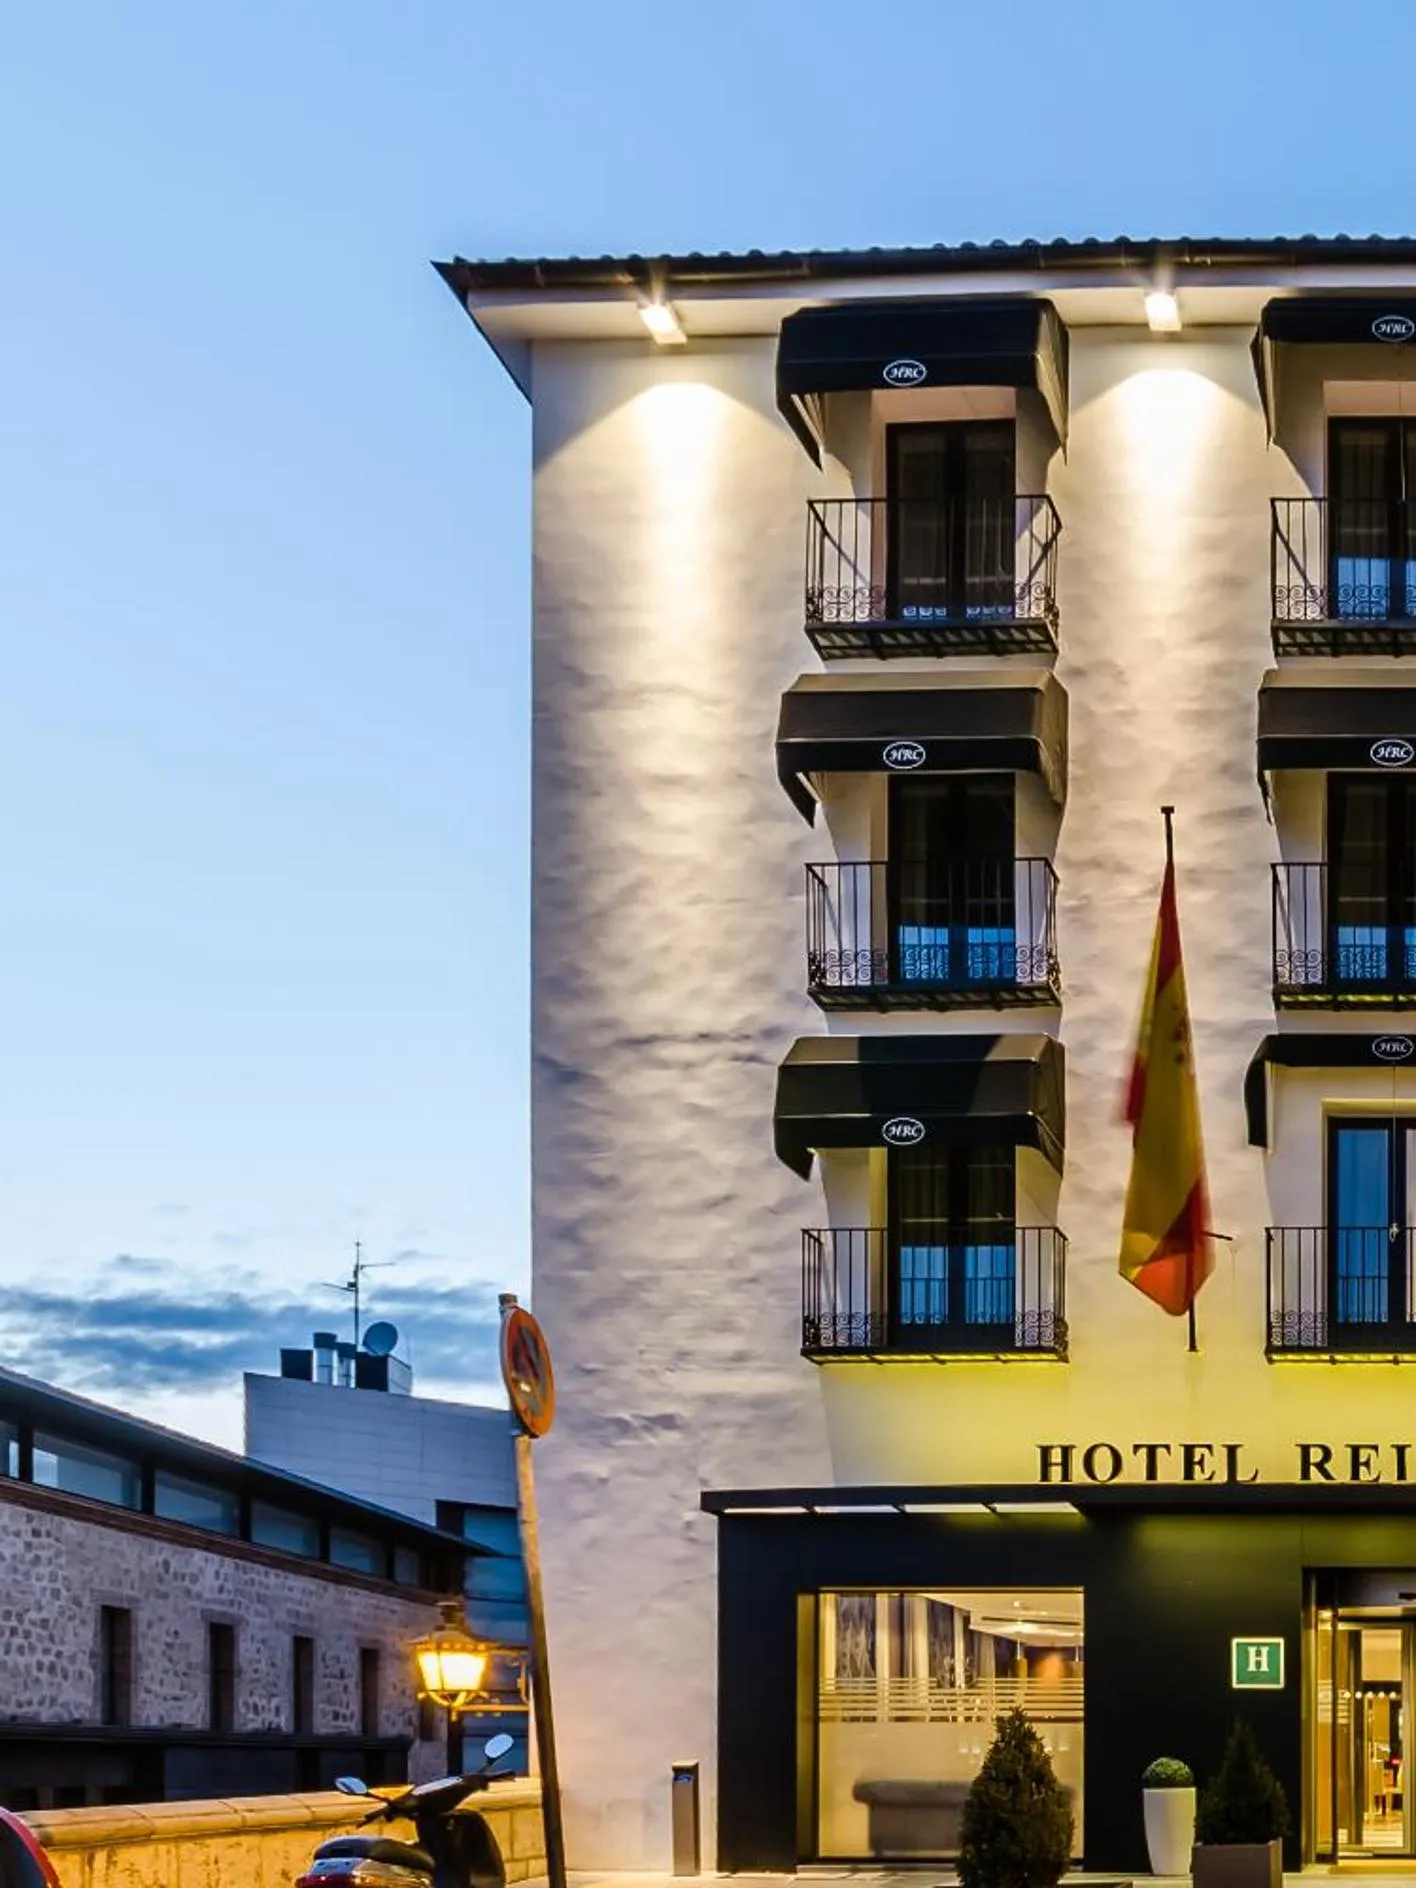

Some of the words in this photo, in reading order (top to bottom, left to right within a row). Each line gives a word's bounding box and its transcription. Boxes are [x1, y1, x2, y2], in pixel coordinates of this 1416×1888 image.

[1378, 322, 1408, 334] HRC
[890, 365, 921, 378] HRC
[889, 748, 919, 760] HRC
[1377, 746, 1408, 758] HRC
[1378, 1042, 1408, 1052] HRC
[888, 1125, 919, 1136] HRC
[1036, 1443, 1259, 1483] HOTEL
[1247, 1646, 1269, 1672] H
